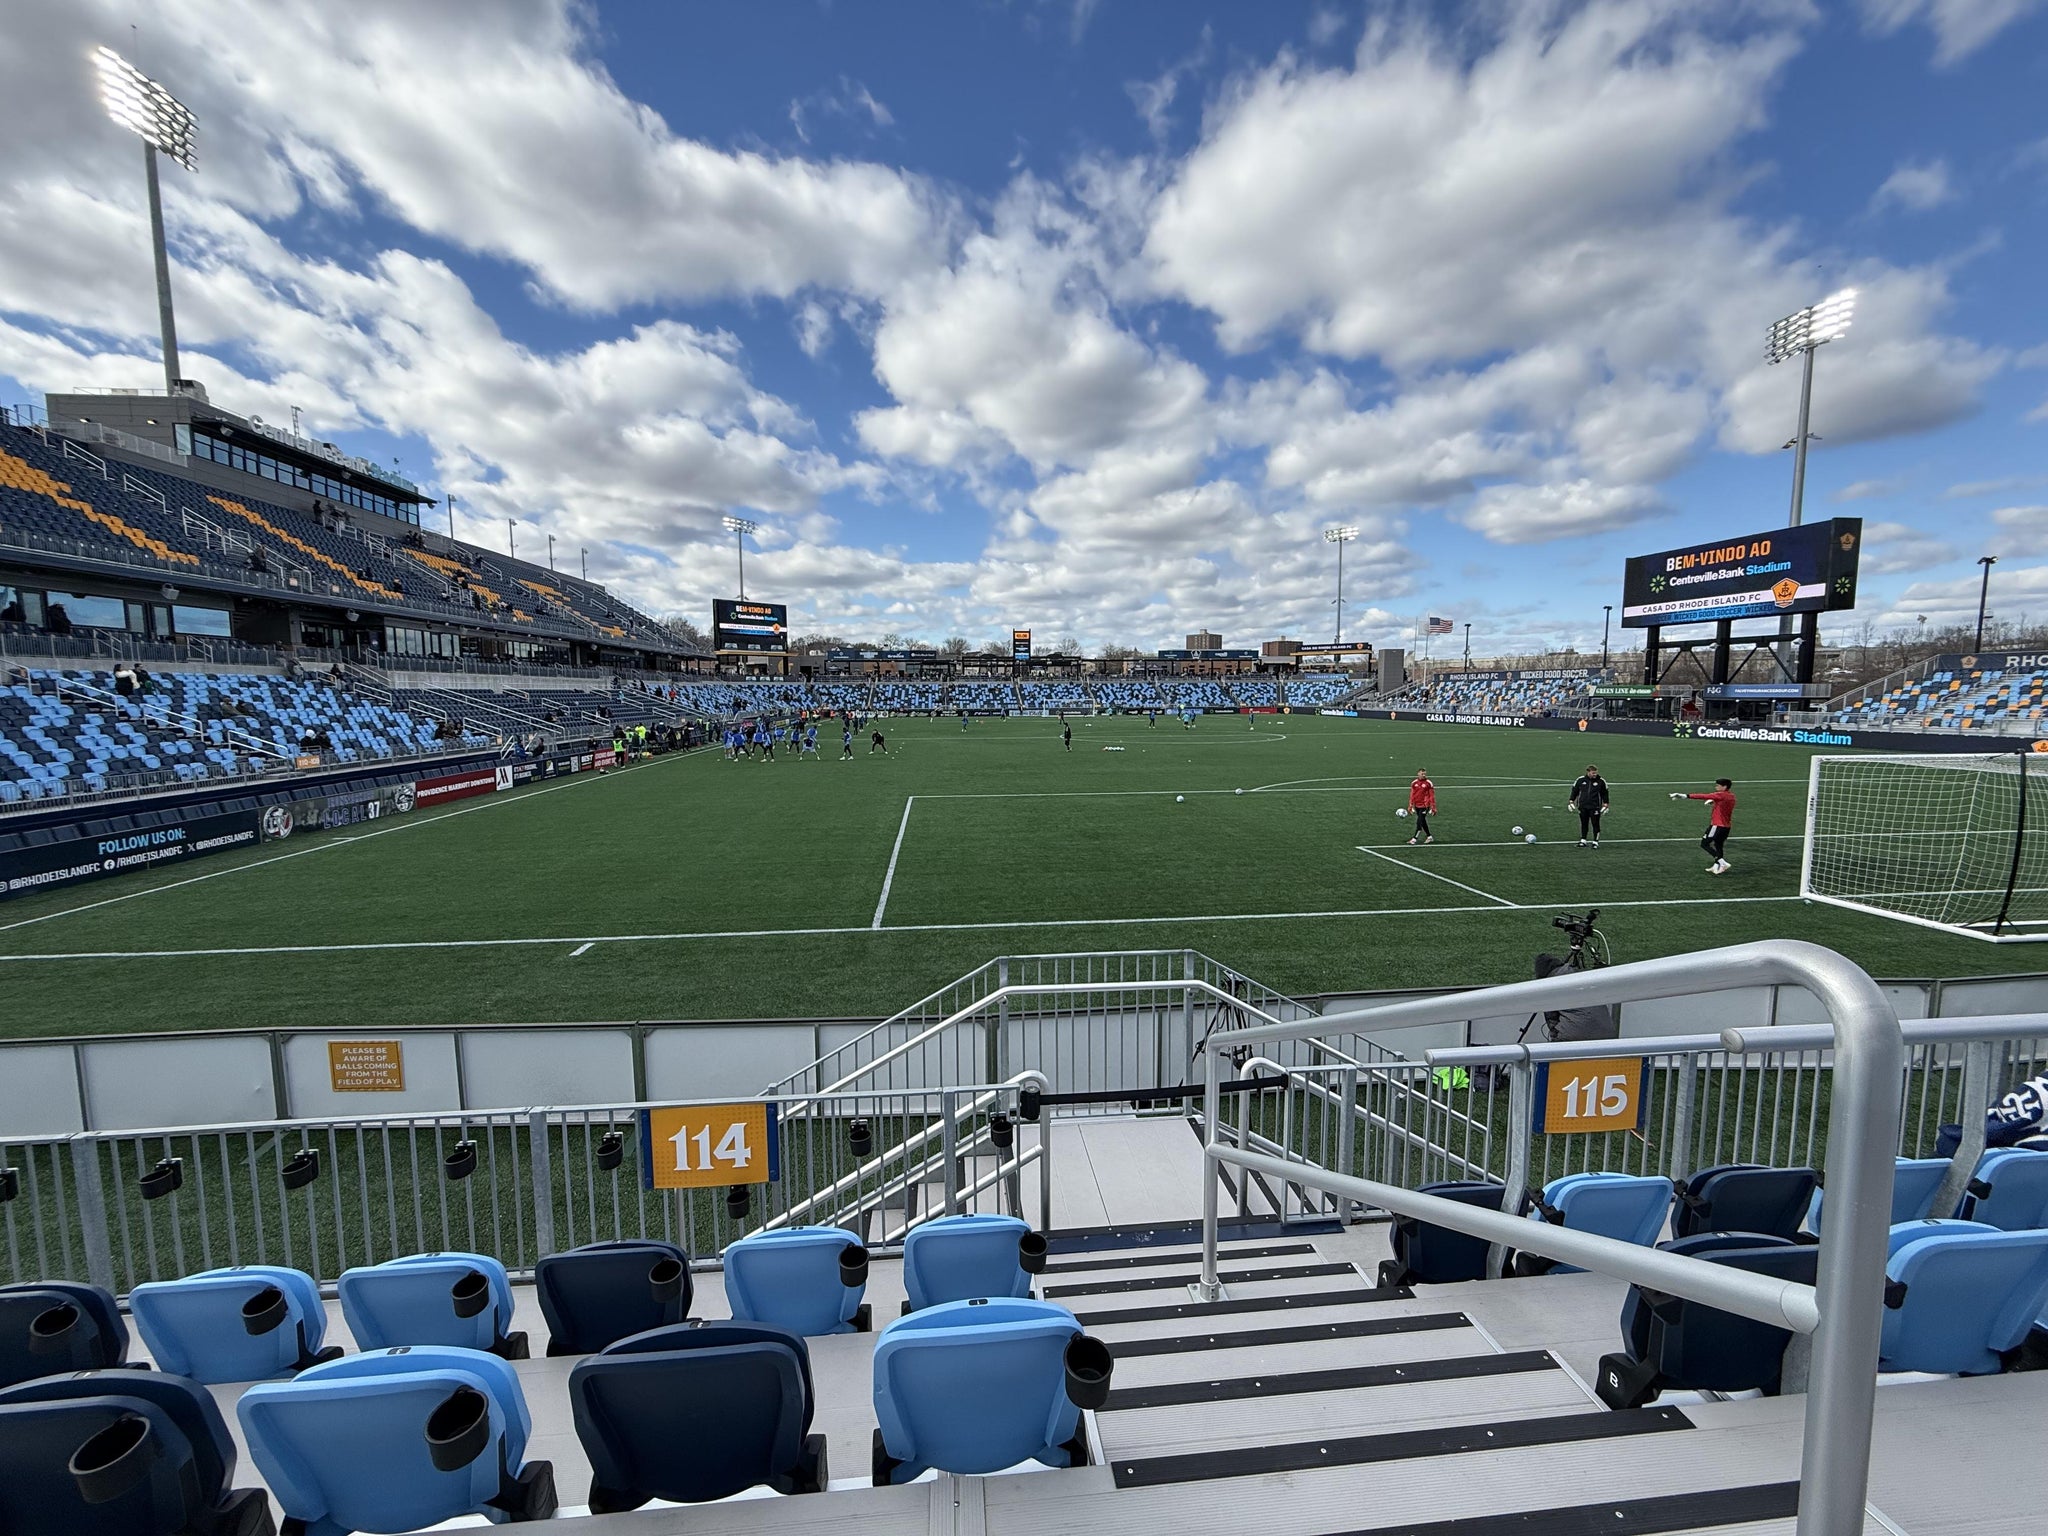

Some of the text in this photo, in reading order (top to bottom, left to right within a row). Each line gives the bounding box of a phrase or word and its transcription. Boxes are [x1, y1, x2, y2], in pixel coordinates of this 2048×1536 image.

[1666, 540, 1771, 572] BEM-VINDO AO
[1669, 561, 1791, 586] CentrevilleBank Stadium
[1642, 593, 1761, 613] CASA DO RHODE ISLAND FC
[1698, 608, 1715, 618] GOOD
[1716, 606, 1742, 616] SOCCER
[2005, 655, 2048, 667] RHO
[1520, 671, 1543, 679] WICKED
[1544, 670, 1561, 678] GOOD
[1426, 713, 1525, 726] CASA DO RHODE ISLAND FC
[1697, 726, 1852, 745] CentrevilleBank Stadium
[417, 776, 495, 798] PROVIDENCE MARRIOTT DOWNTOWN
[322, 800, 380, 829] LOCAL 37
[98, 827, 187, 855] FOLLOW US ON:
[9, 862, 101, 890] @RHODEISLANDFC
[116, 844, 183, 869] /RHODEISLANDFC
[196, 830, 254, 851] @RHODEISLANDFC
[1561, 1074, 1628, 1118] 115
[668, 1122, 752, 1171] 114
[1610, 1371, 1618, 1388] B
